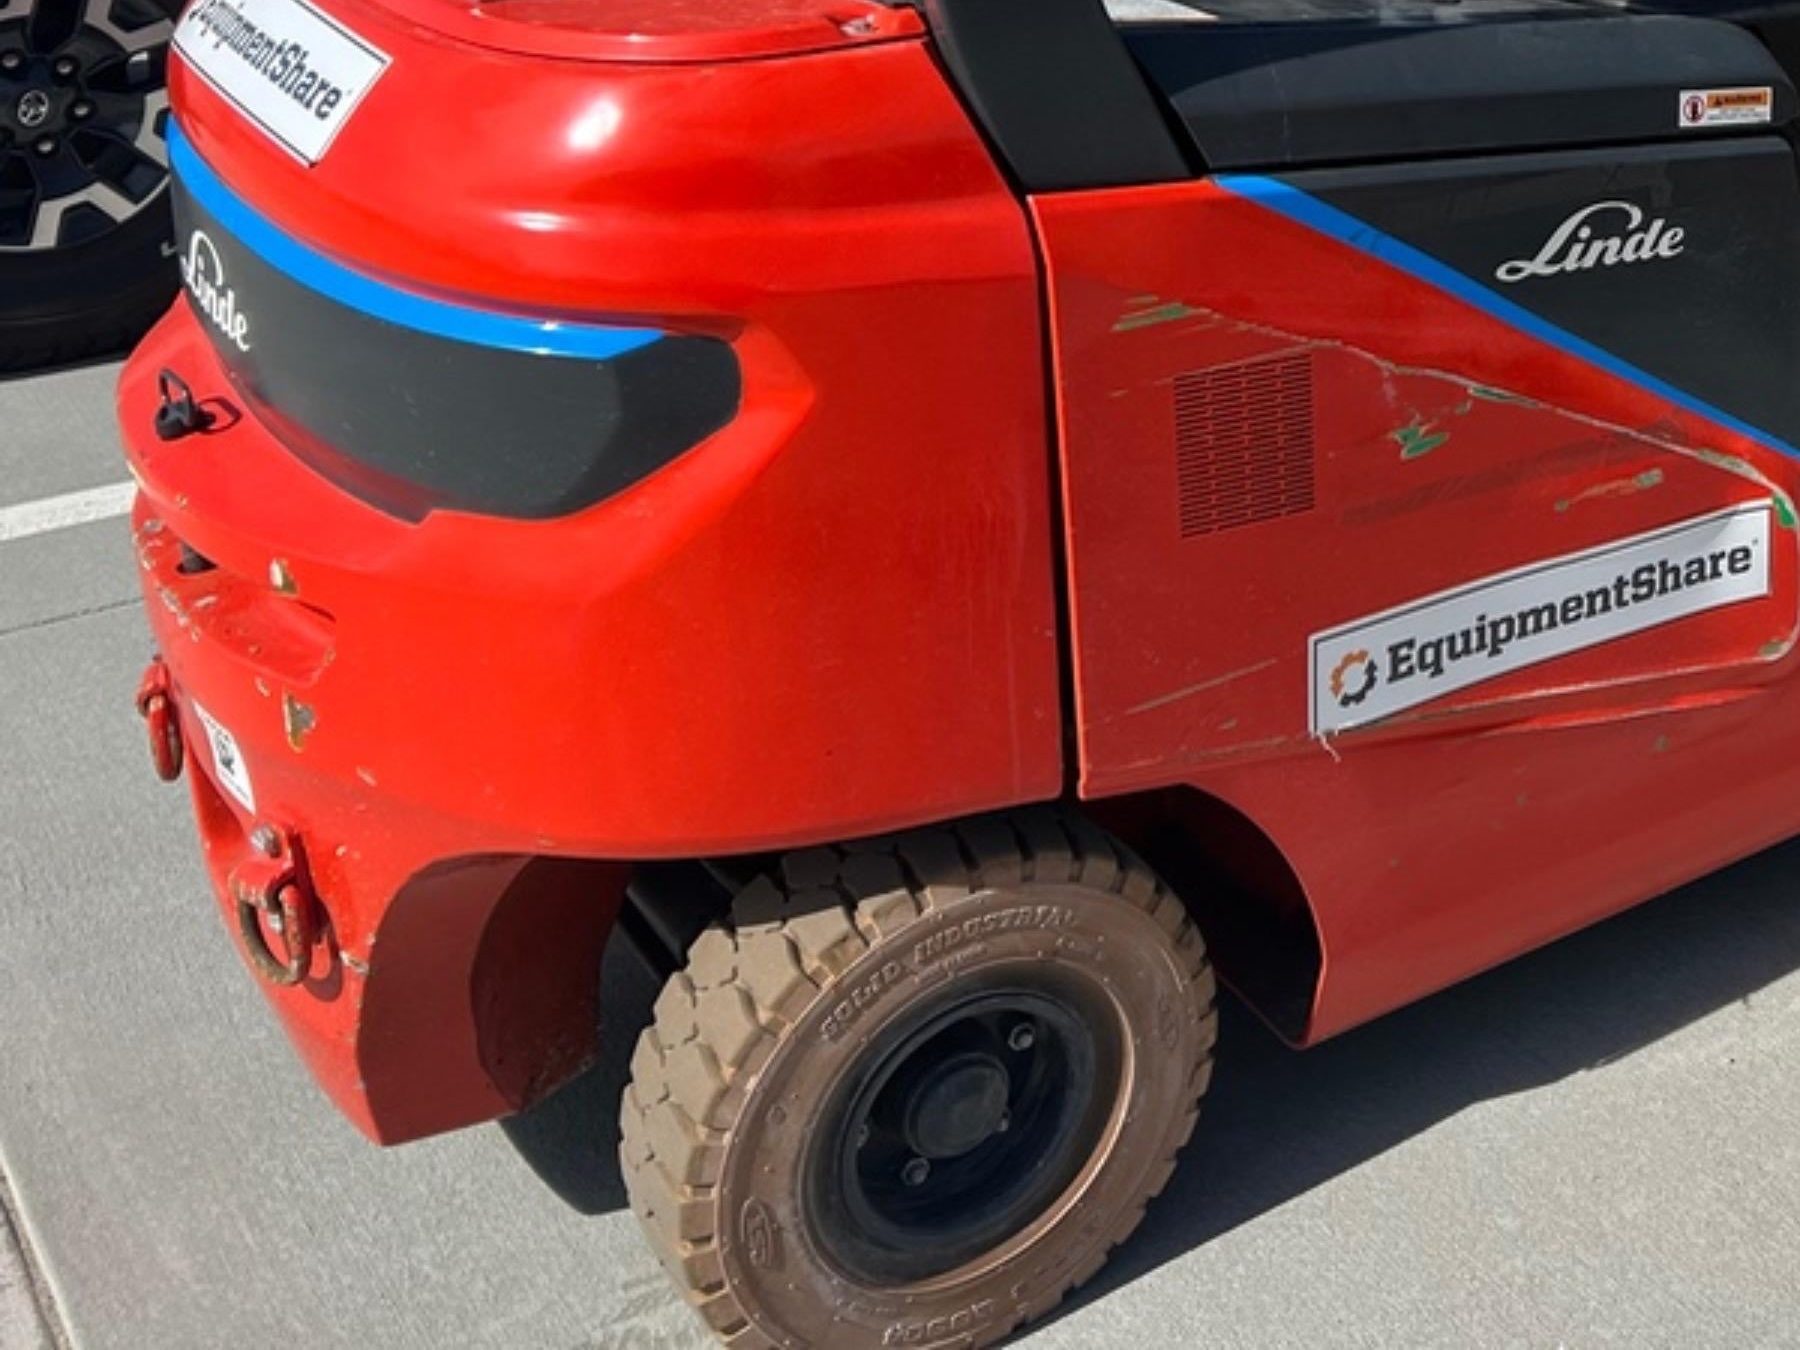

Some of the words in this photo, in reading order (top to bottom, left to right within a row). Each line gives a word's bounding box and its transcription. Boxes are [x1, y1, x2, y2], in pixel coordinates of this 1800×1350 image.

[180, 230, 249, 351] Linde
[1495, 201, 1684, 282] Linde
[1386, 544, 1752, 684] EquipmentShare
